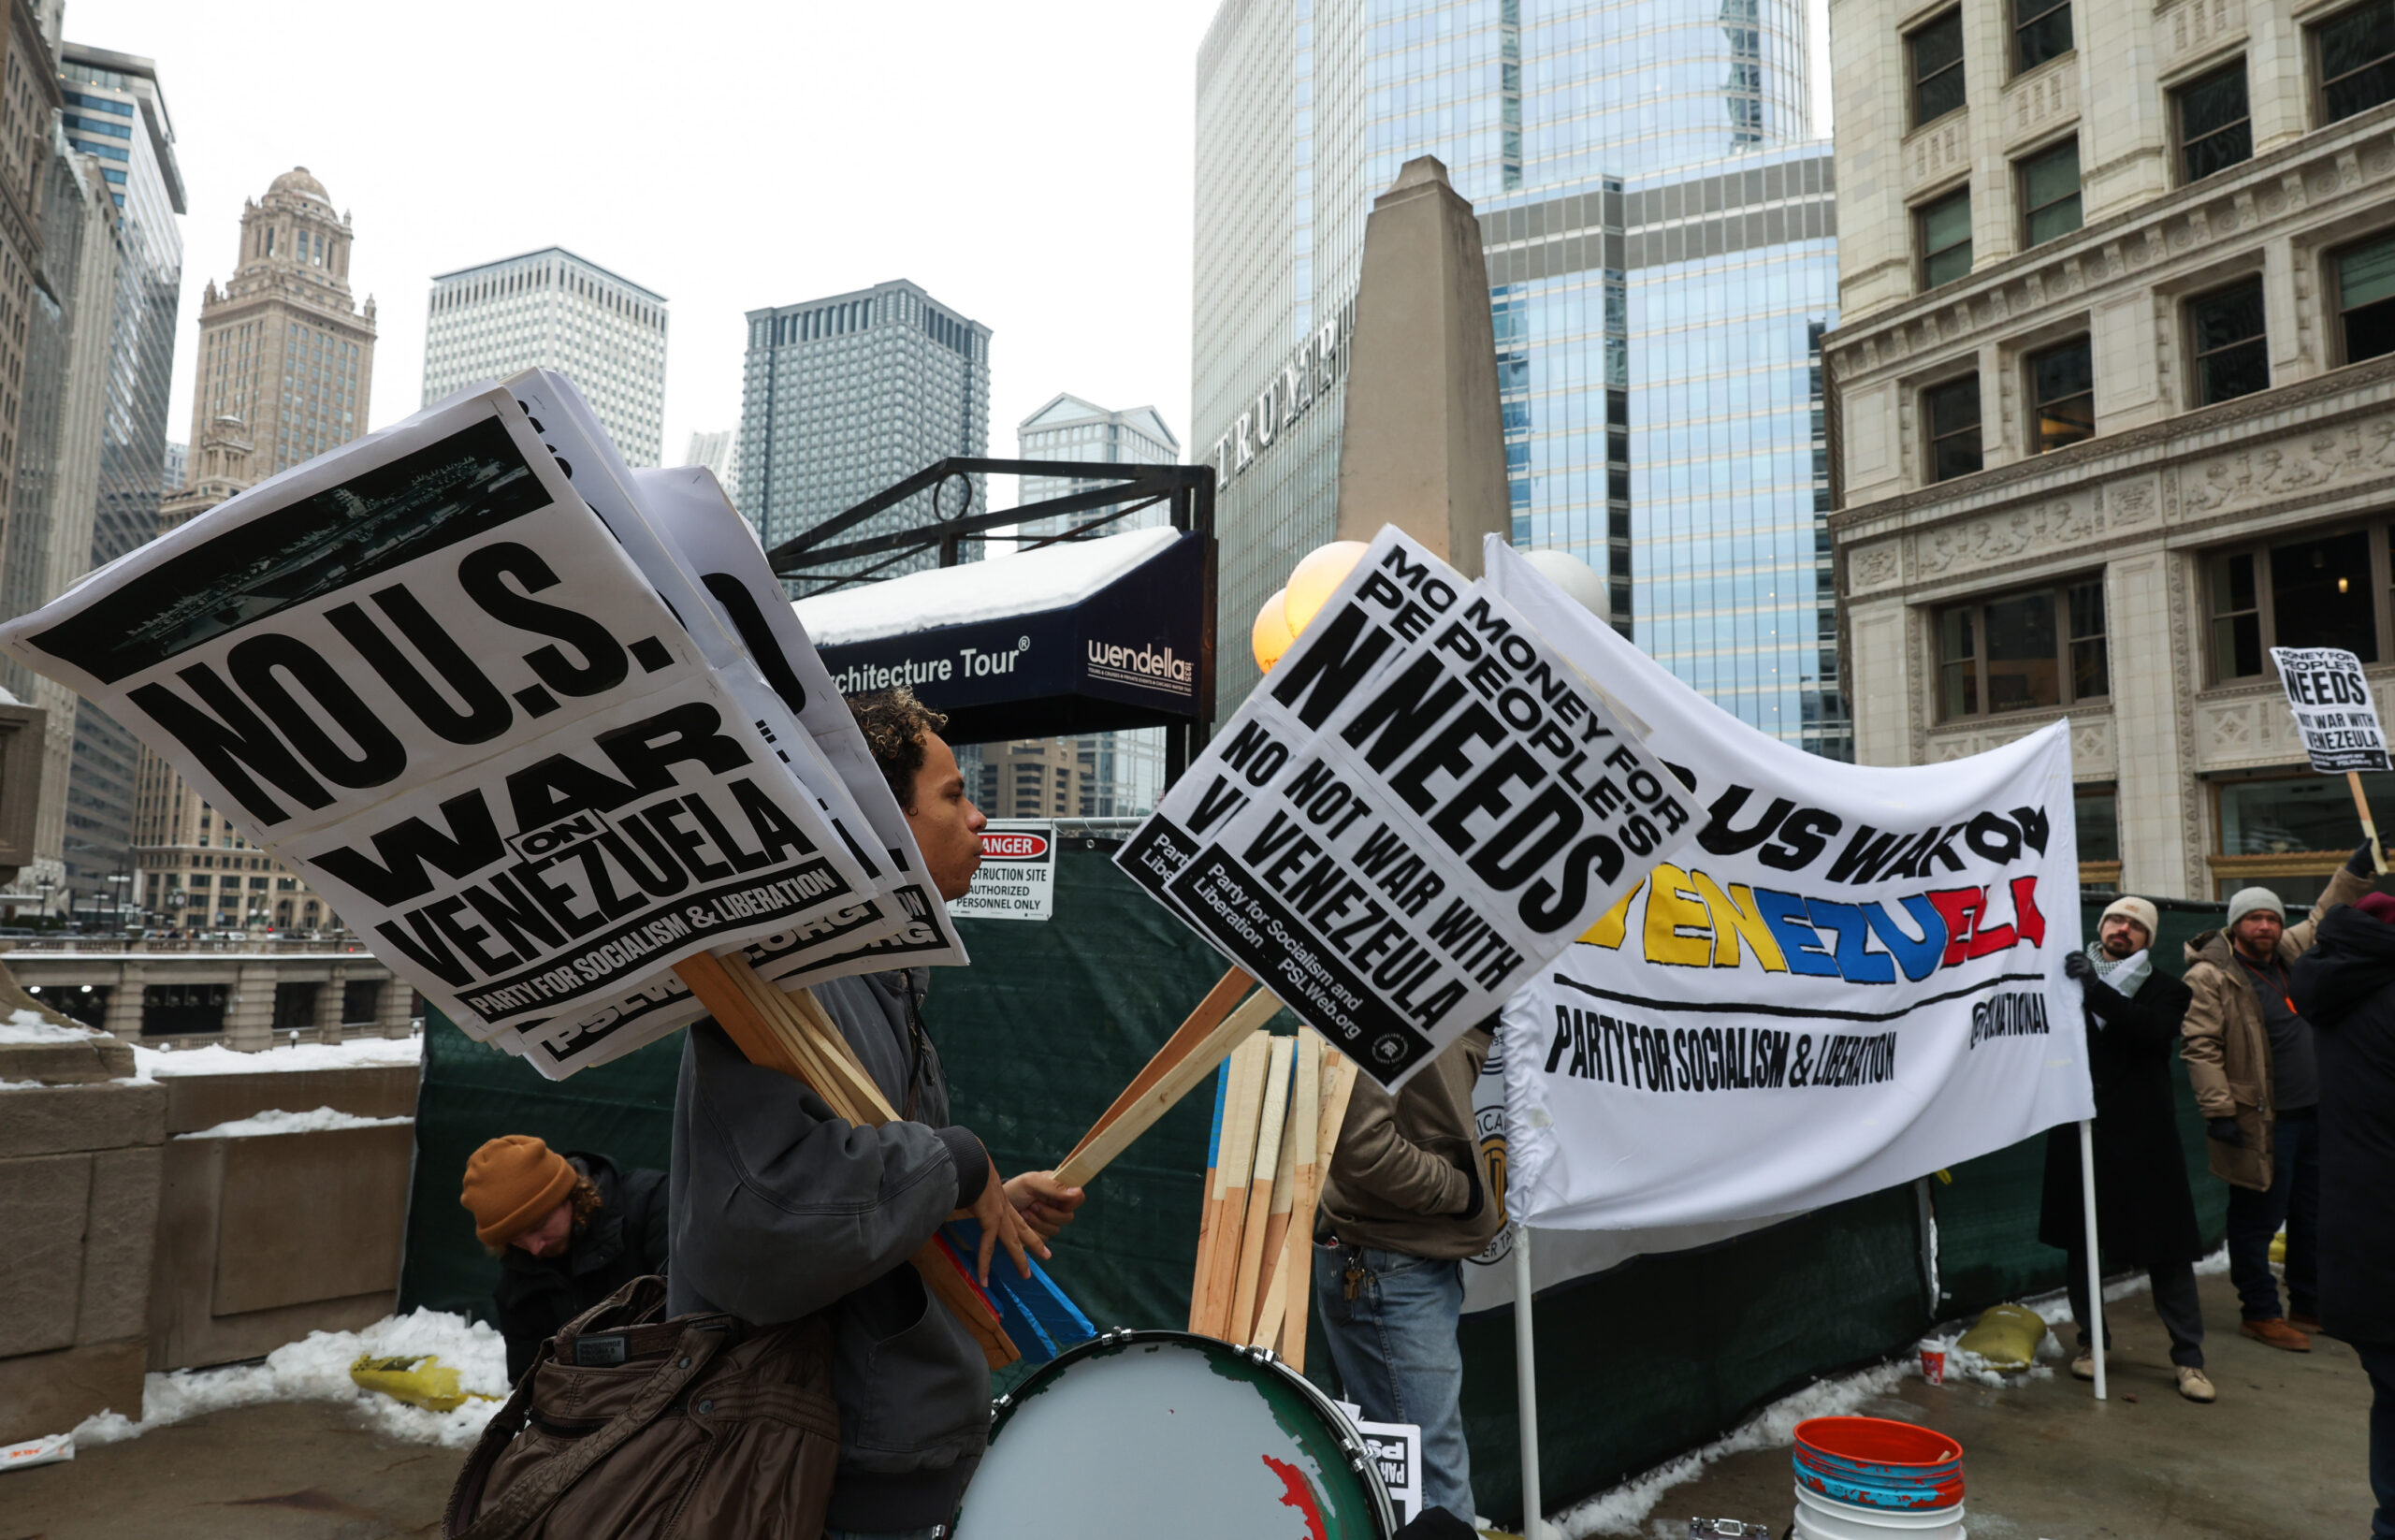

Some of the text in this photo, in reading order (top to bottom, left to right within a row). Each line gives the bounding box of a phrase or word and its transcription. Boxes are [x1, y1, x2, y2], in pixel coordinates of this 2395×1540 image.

[1215, 319, 1337, 490] TRUMP
[125, 633, 407, 826] NO
[323, 542, 675, 745] U.S.
[831, 659, 952, 693] chitecture
[1088, 639, 1185, 681] wendella
[2276, 649, 2356, 661] MONEY FOR
[2285, 669, 2366, 705] NEEDS
[1433, 620, 1662, 857] PEOPLE'S
[1463, 597, 1690, 835] MONEY FOR
[2314, 714, 2346, 729] WAR
[2347, 713, 2376, 727] WITH
[307, 702, 752, 908] WAR
[521, 816, 595, 854] ON
[982, 837, 1034, 854] ANGER
[1153, 833, 1190, 868] Part
[1340, 650, 1625, 934] NEEDS
[1696, 784, 1843, 871] US
[374, 777, 820, 989] VENEZUELA
[956, 898, 1041, 909] PERSONNEL ONLY
[973, 868, 1048, 881] STRUCTION SITE
[1241, 808, 1469, 1032] VENEZEULA
[1283, 757, 1372, 842] NOT
[1351, 821, 1446, 920] WAR
[1427, 896, 1526, 994] WITH
[468, 868, 838, 1015] PARTY FOR SOCIALISM & LIBERATION
[1193, 877, 1362, 1040] Liberation PSLWeb.org
[1207, 863, 1250, 906] Party
[1245, 900, 1270, 925] for
[1267, 920, 1335, 986] Socialism
[1330, 979, 1364, 1011] and
[1544, 1004, 1898, 1093] PARTY FOR SOCIALISM & LIBERATION
